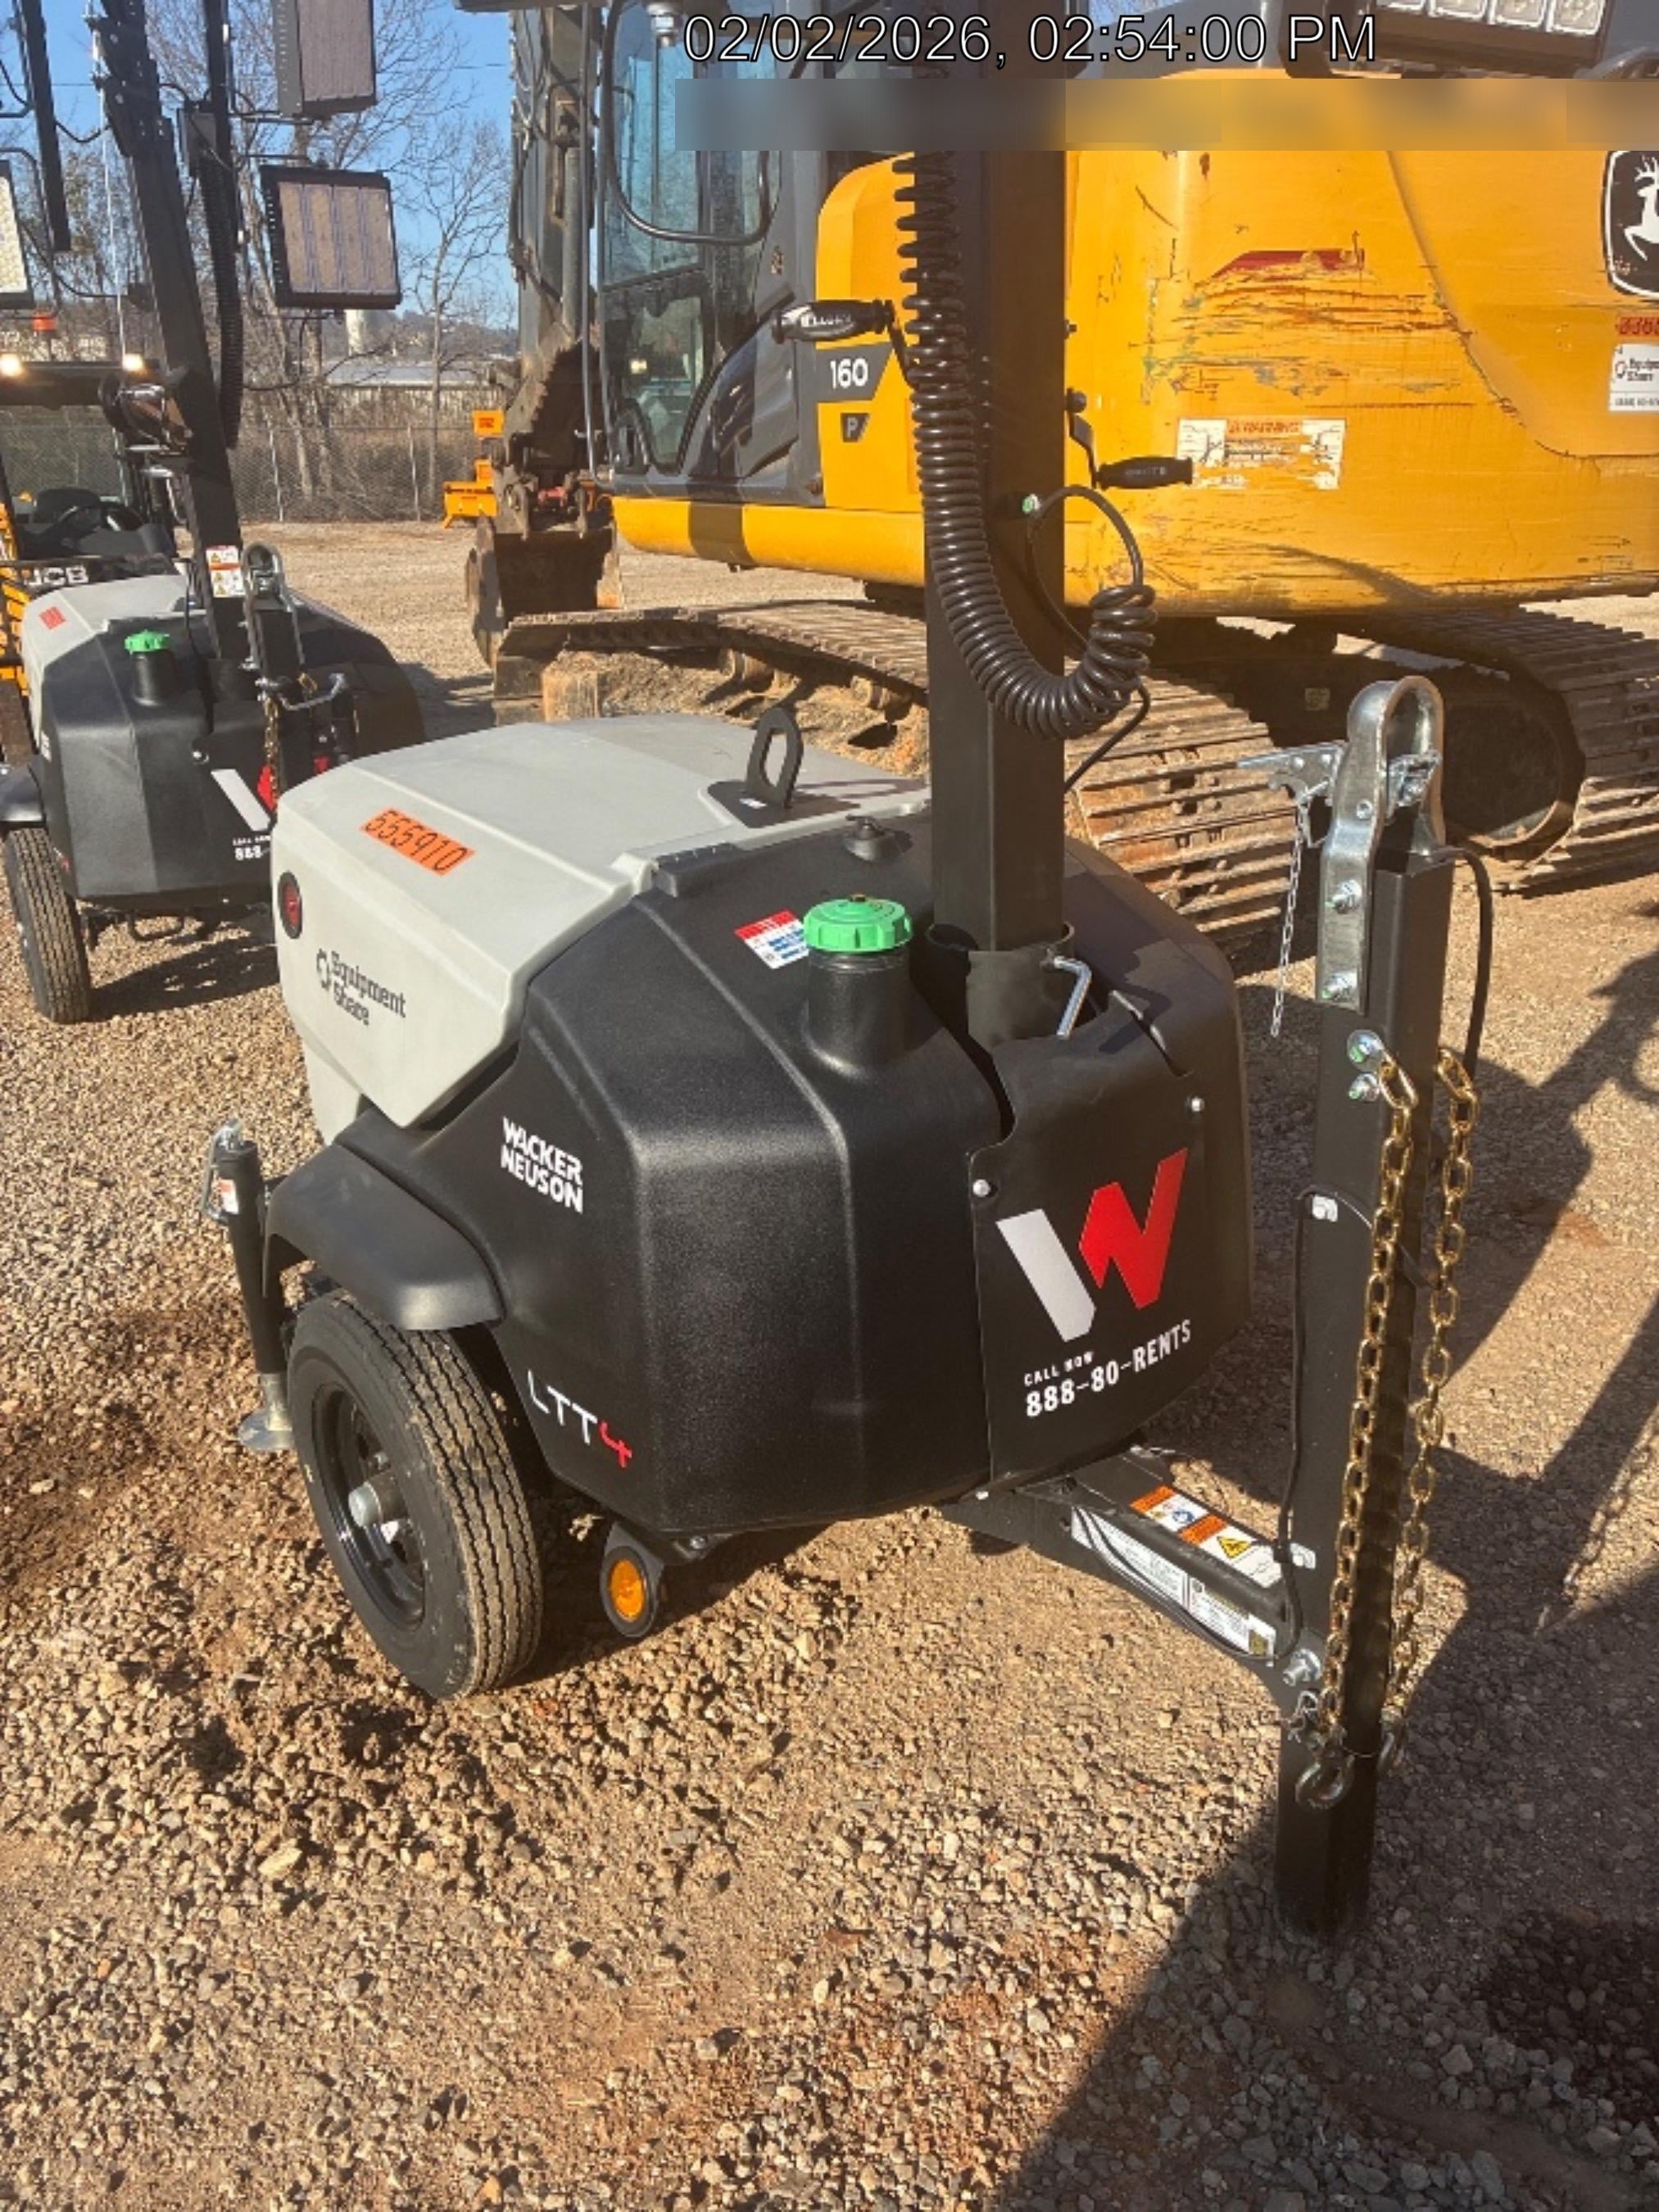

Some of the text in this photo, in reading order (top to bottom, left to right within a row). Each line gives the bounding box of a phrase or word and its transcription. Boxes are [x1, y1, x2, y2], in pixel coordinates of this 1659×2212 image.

[830, 358, 868, 389] 160
[29, 566, 89, 585] JCB
[331, 950, 406, 1018] Equipment
[333, 981, 369, 1026] Share
[500, 1144, 583, 1214] NEUSON
[502, 1116, 583, 1186] WACKER
[1024, 1351, 1094, 1386] CALL NOW
[1026, 1319, 1191, 1417] 888-80-RENTS
[527, 1369, 633, 1468] LTT4
